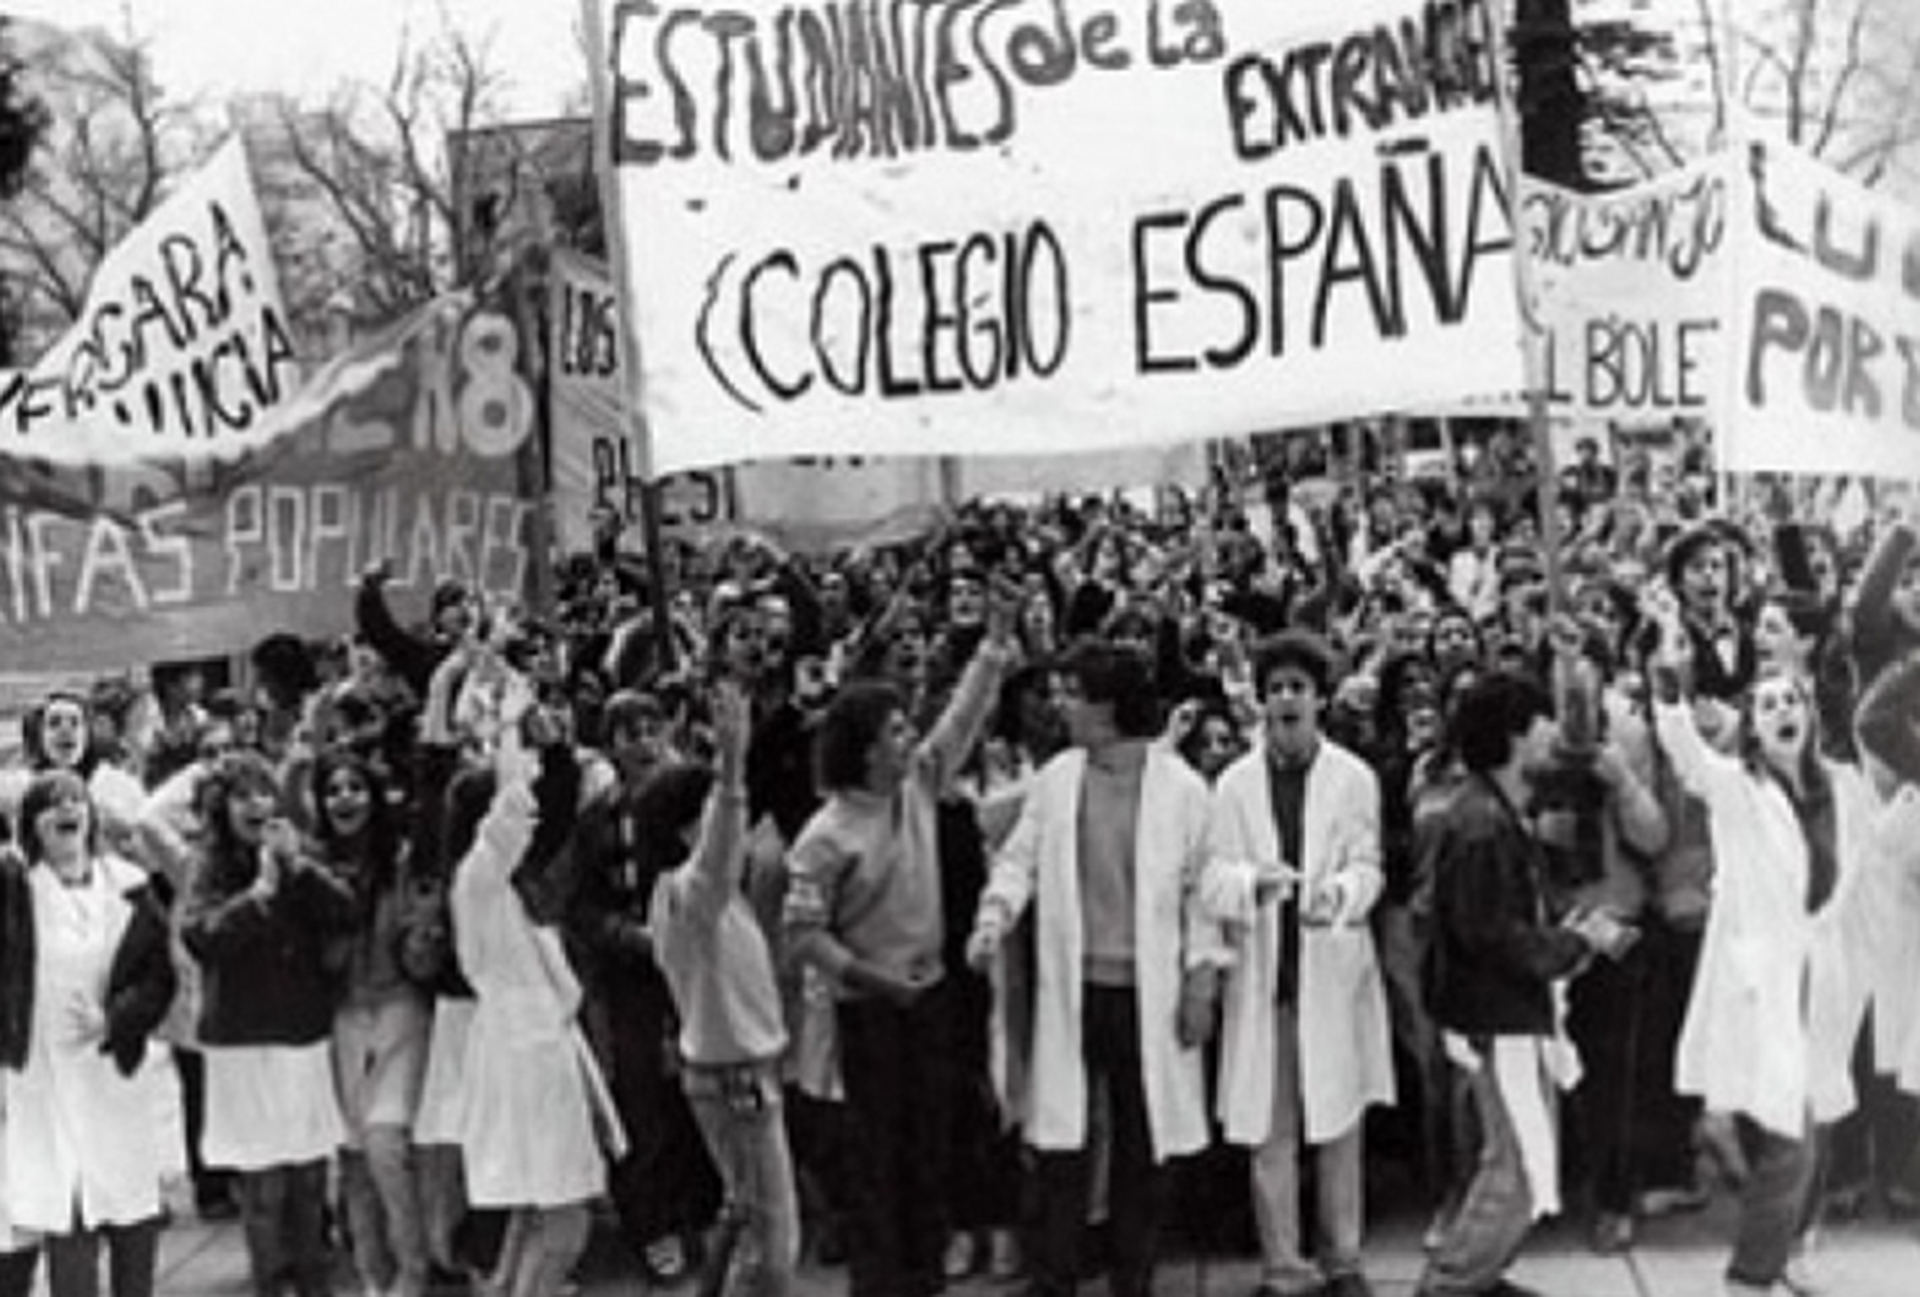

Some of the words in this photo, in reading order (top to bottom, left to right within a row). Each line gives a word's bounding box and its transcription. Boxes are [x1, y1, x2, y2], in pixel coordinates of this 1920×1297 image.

[1006, 0, 1131, 86] de
[1133, 134, 1514, 375] ESPAÑA
[1748, 140, 1920, 298] LU
[0, 499, 193, 622] IFAS
